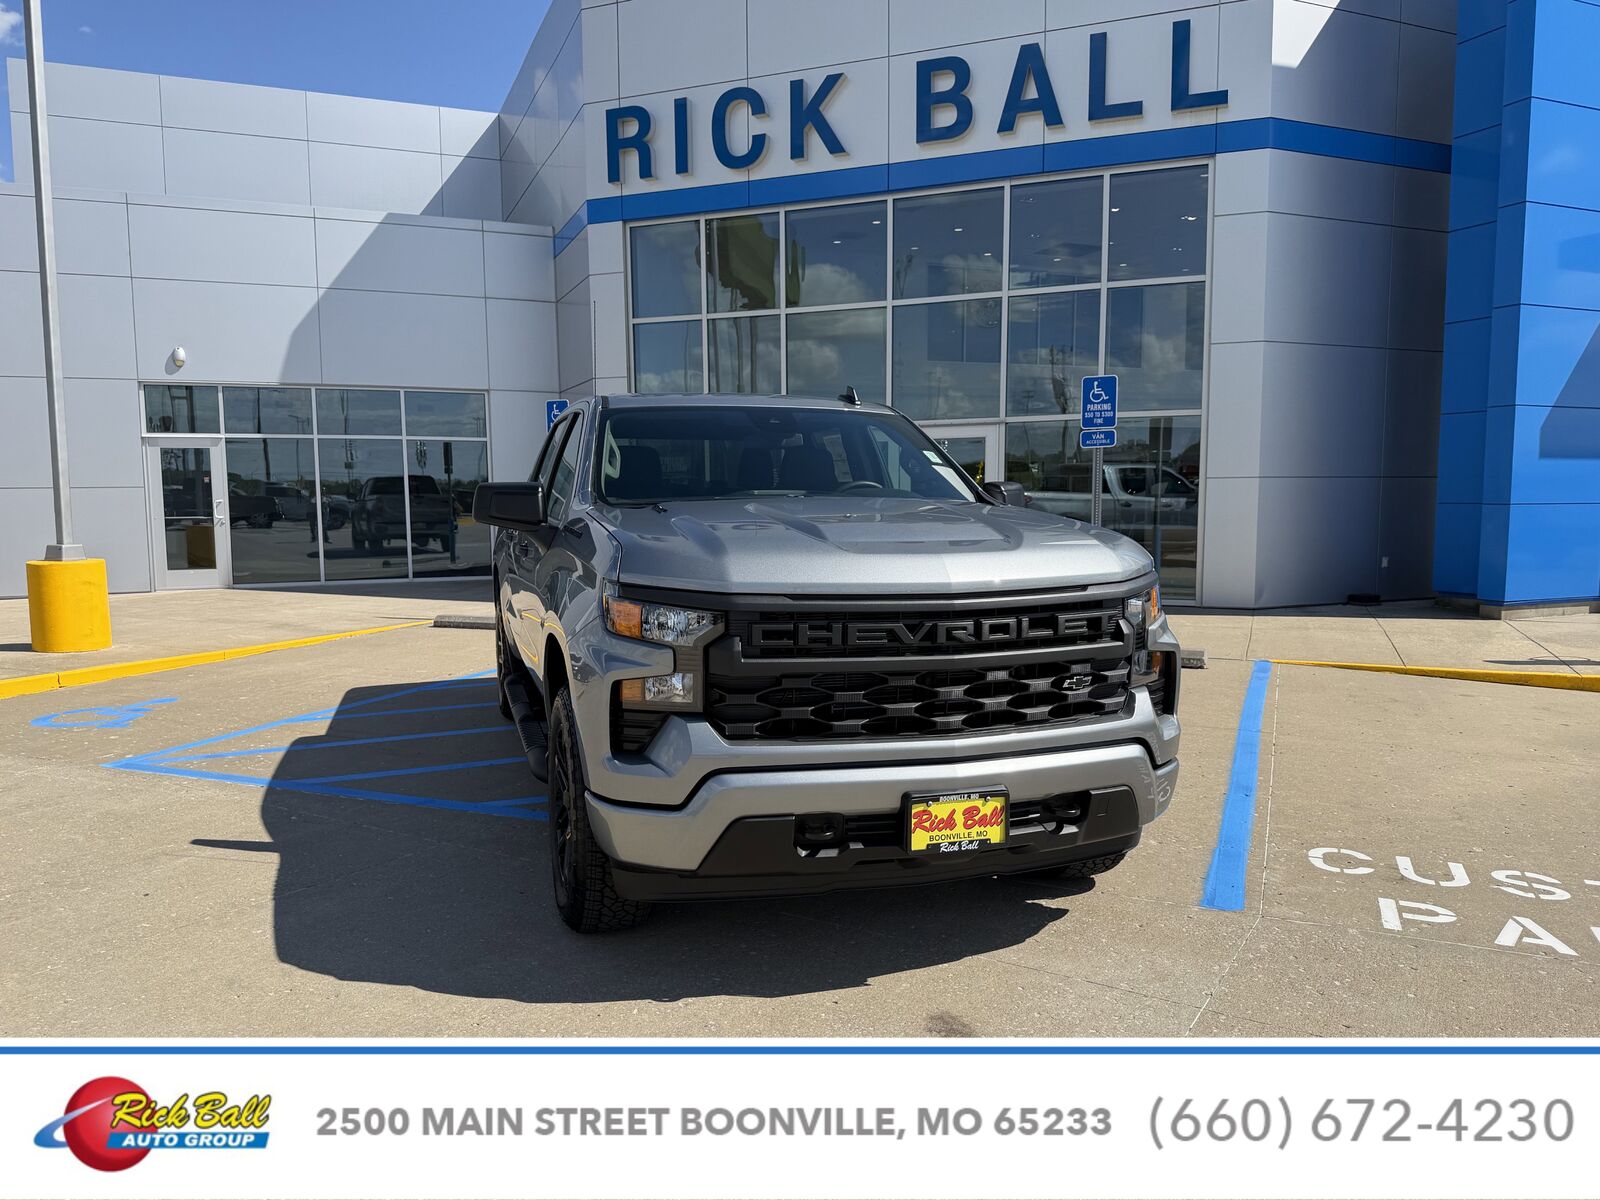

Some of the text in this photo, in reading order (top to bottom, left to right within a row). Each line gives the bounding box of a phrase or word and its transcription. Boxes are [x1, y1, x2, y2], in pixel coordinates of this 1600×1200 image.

[605, 19, 1229, 184] RICK BALL
[1086, 403, 1112, 411] PARKING
[939, 795, 970, 803] BOONVILLE,
[911, 804, 1004, 834] Rick Ball
[929, 831, 975, 842] BOONVILLE,
[939, 840, 980, 853] Rick Ball
[1308, 847, 1600, 900] CUS
[1377, 896, 1600, 956] PA
